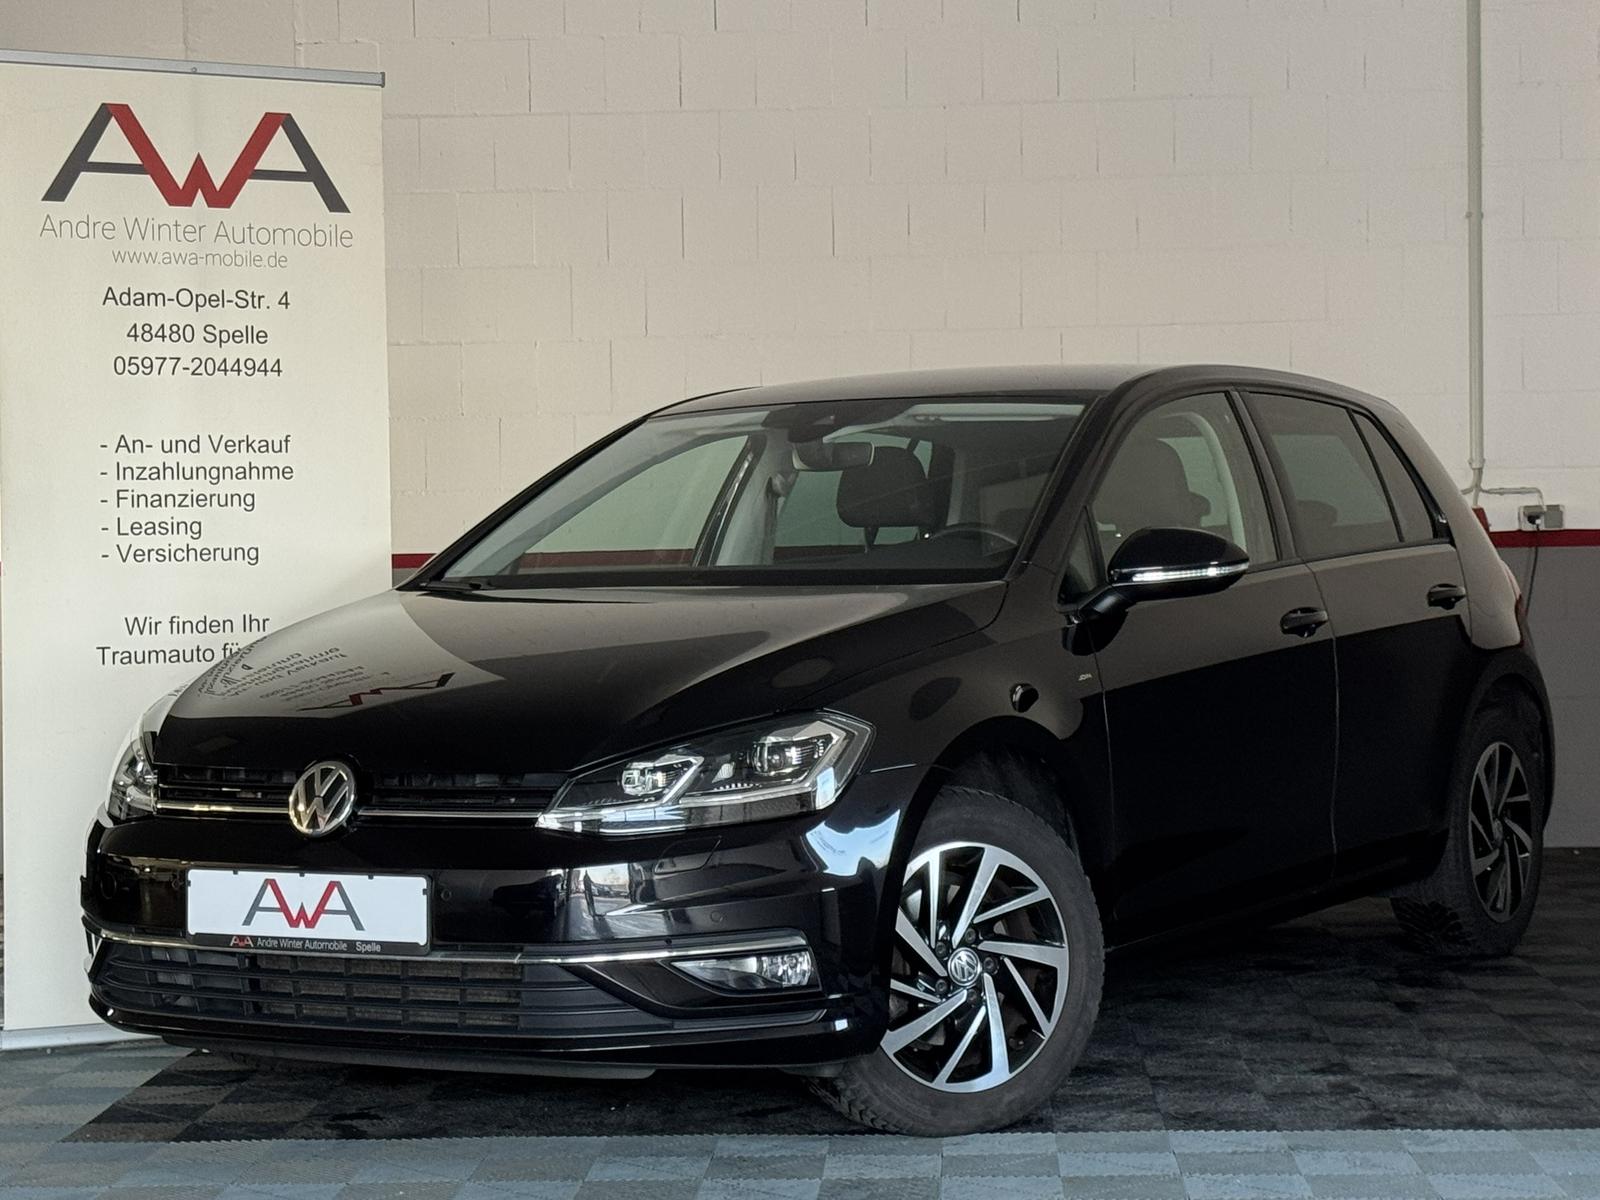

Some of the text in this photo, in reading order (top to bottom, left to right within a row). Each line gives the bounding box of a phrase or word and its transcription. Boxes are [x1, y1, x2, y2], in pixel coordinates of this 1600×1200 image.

[40, 102, 352, 214] AWA
[39, 213, 354, 249] Andre Winter Automobile
[111, 249, 288, 269] www.awa-mobile.de
[102, 286, 291, 313] Adam-Opel-Str. 4
[126, 322, 269, 349] 48480 Spelle
[113, 355, 283, 377] 05977-2044944
[114, 434, 153, 454] An-
[160, 434, 201, 454] und
[207, 434, 292, 454] Verkauf
[116, 461, 294, 486] Inzahlungnahme
[116, 488, 256, 513] Finanzierung
[116, 516, 202, 541] Leasing
[115, 542, 259, 566] Versicherung
[124, 613, 270, 636] Wir finden Ihr
[96, 645, 215, 666] Traumauto
[241, 877, 366, 932] AWA
[257, 938, 278, 948] Andre
[280, 939, 303, 949] Winter
[304, 940, 348, 951] Automobile
[355, 942, 382, 953] Spelle
